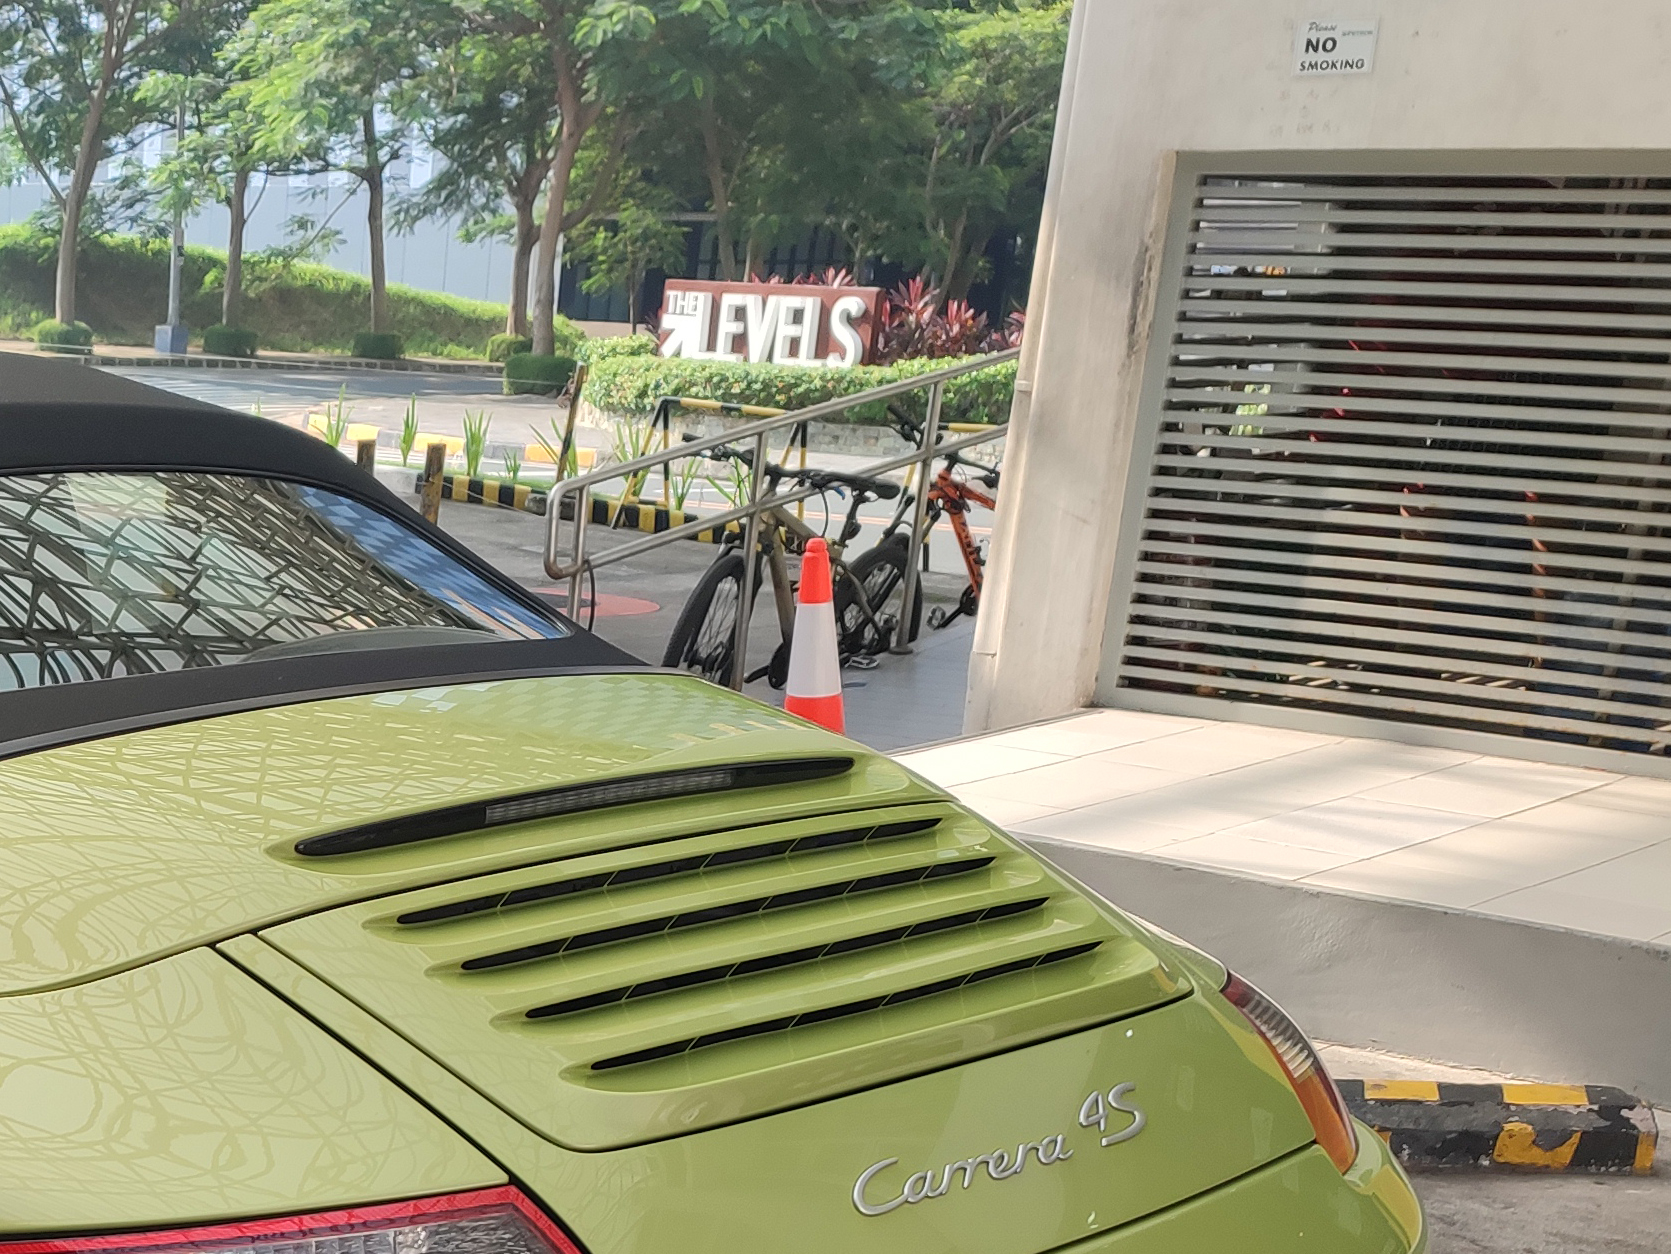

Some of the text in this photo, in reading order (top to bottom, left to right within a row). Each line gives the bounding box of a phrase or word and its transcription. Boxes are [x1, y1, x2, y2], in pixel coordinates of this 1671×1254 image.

[1304, 36, 1337, 54] NO
[1299, 58, 1365, 72] SMOKING
[667, 290, 698, 315] THE
[662, 292, 867, 368] LEVELS
[852, 1082, 1147, 1216] Carrera 4S
